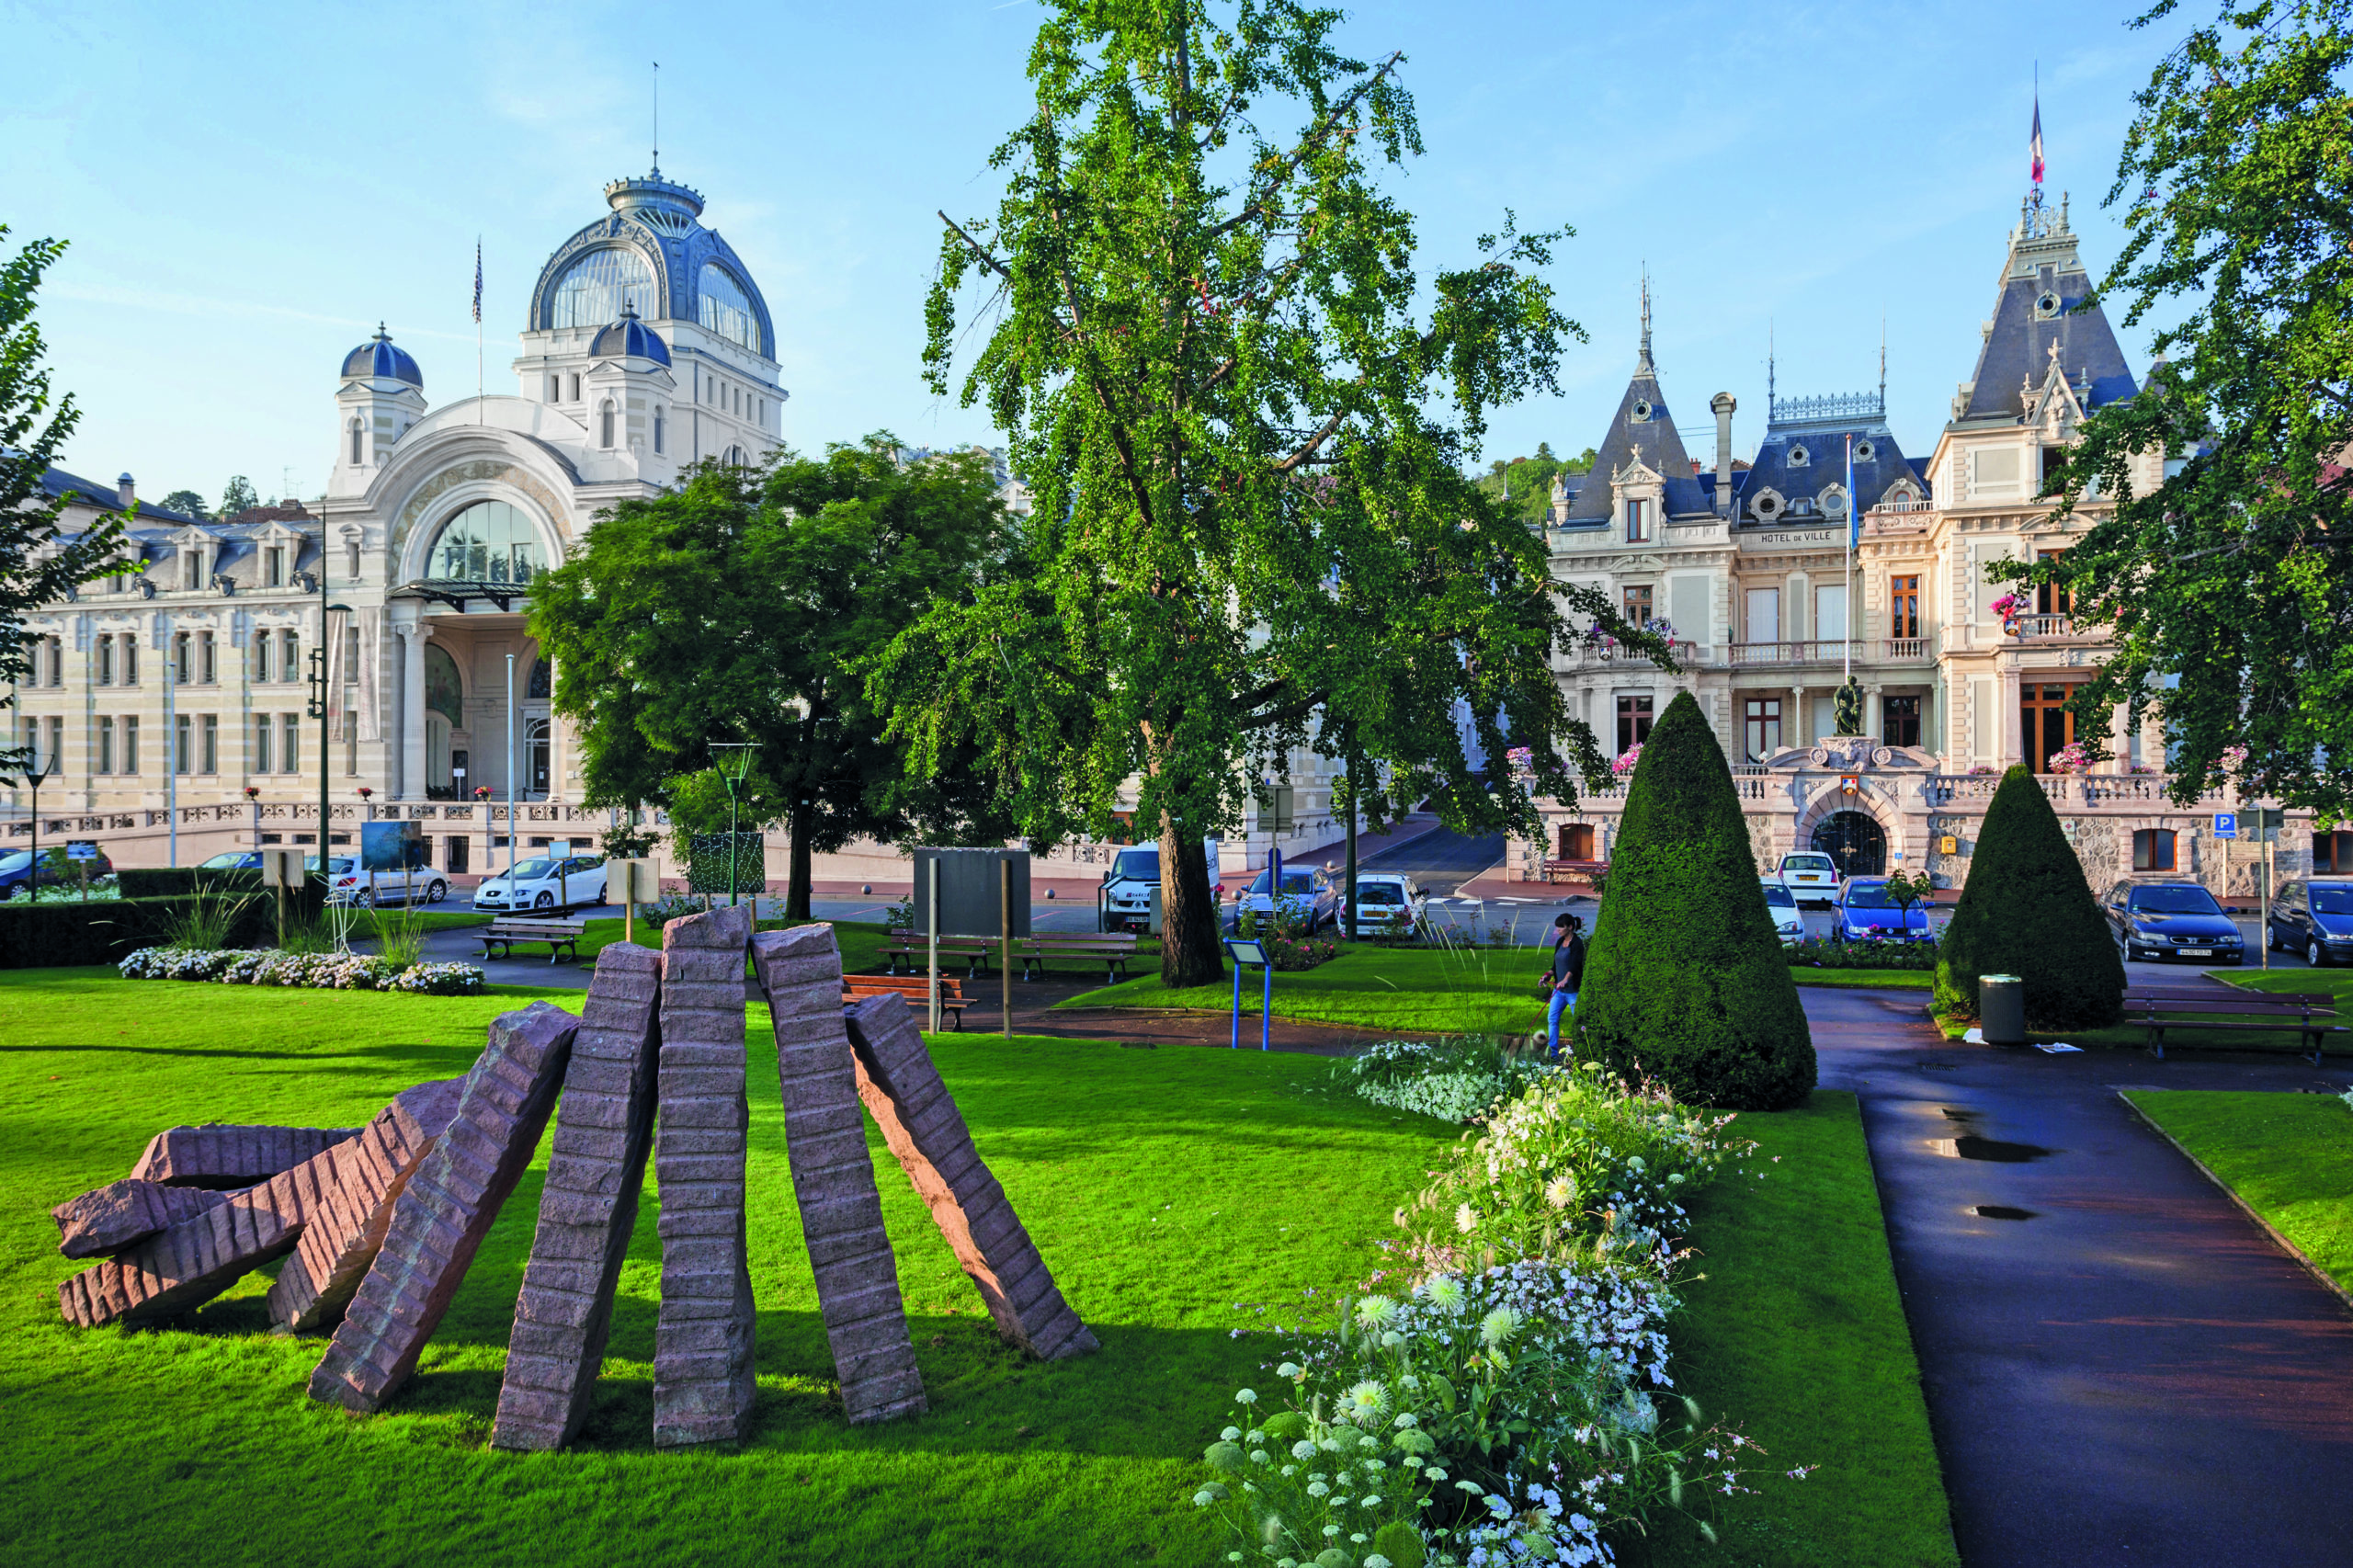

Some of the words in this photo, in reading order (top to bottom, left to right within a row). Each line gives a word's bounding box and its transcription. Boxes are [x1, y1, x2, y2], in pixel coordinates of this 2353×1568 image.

[1762, 534, 1791, 542] HOTEL
[1804, 531, 1831, 540] VILLE
[2220, 816, 2230, 829] P
